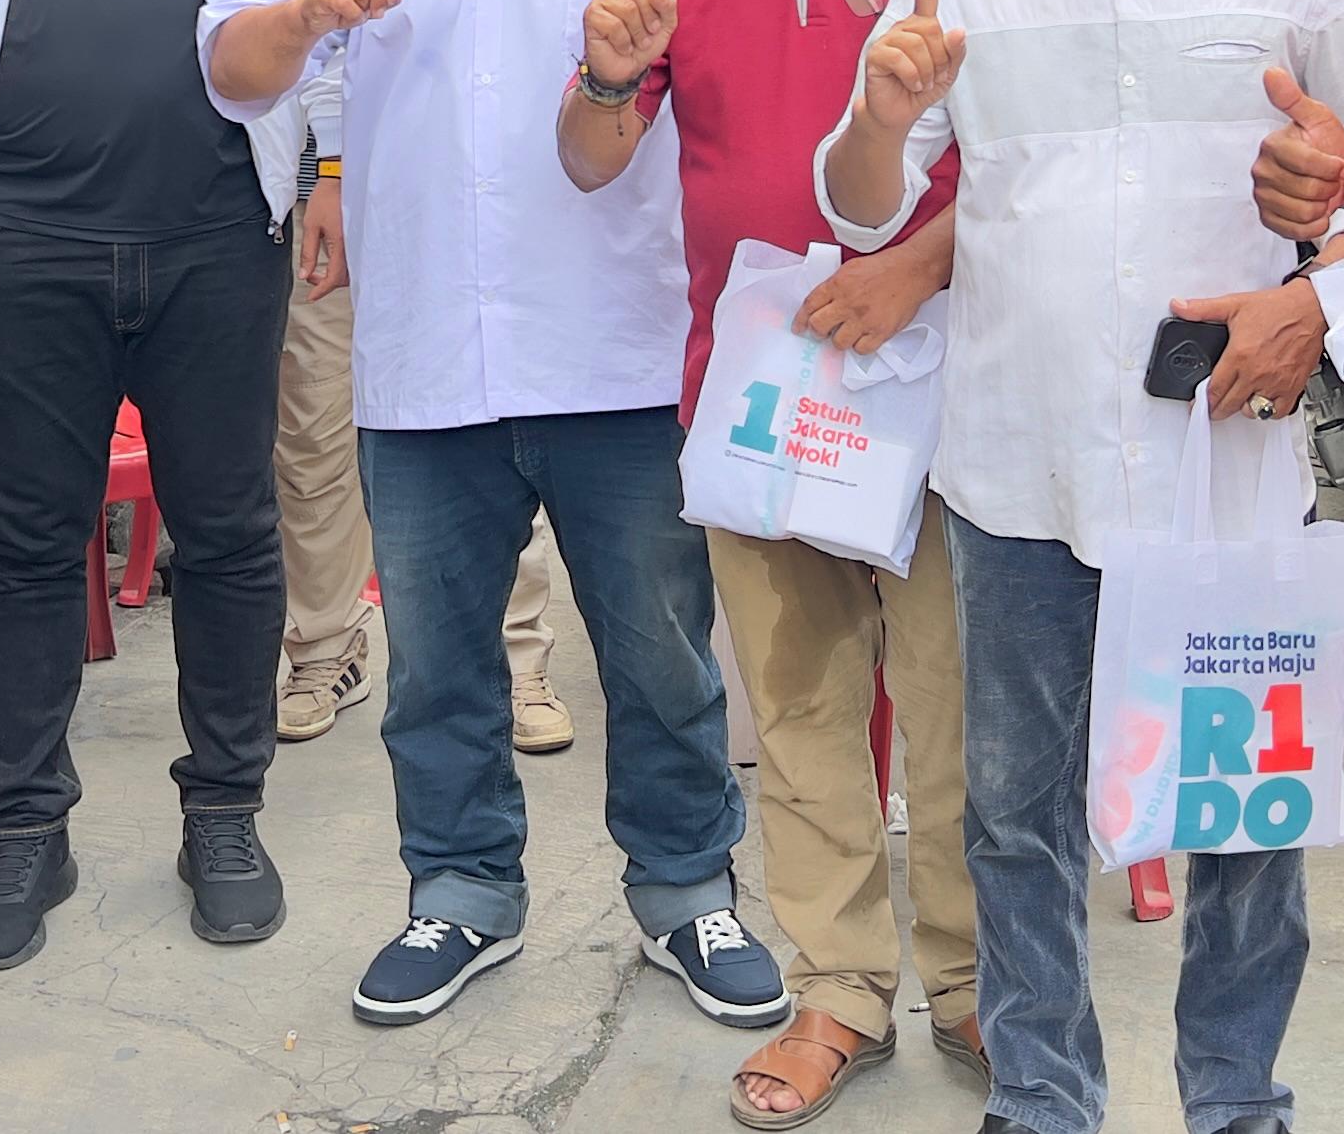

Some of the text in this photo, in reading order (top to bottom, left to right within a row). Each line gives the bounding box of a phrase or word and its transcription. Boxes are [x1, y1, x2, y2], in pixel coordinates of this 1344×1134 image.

[729, 380, 782, 454] 1
[797, 397, 862, 427] Satuin
[789, 417, 869, 451] Jakarta
[785, 439, 840, 468] Nyok!
[1185, 631, 1316, 652] Jakarta Baru
[1184, 653, 1316, 677] Jakarta Maju
[1171, 776, 1313, 851] DO
